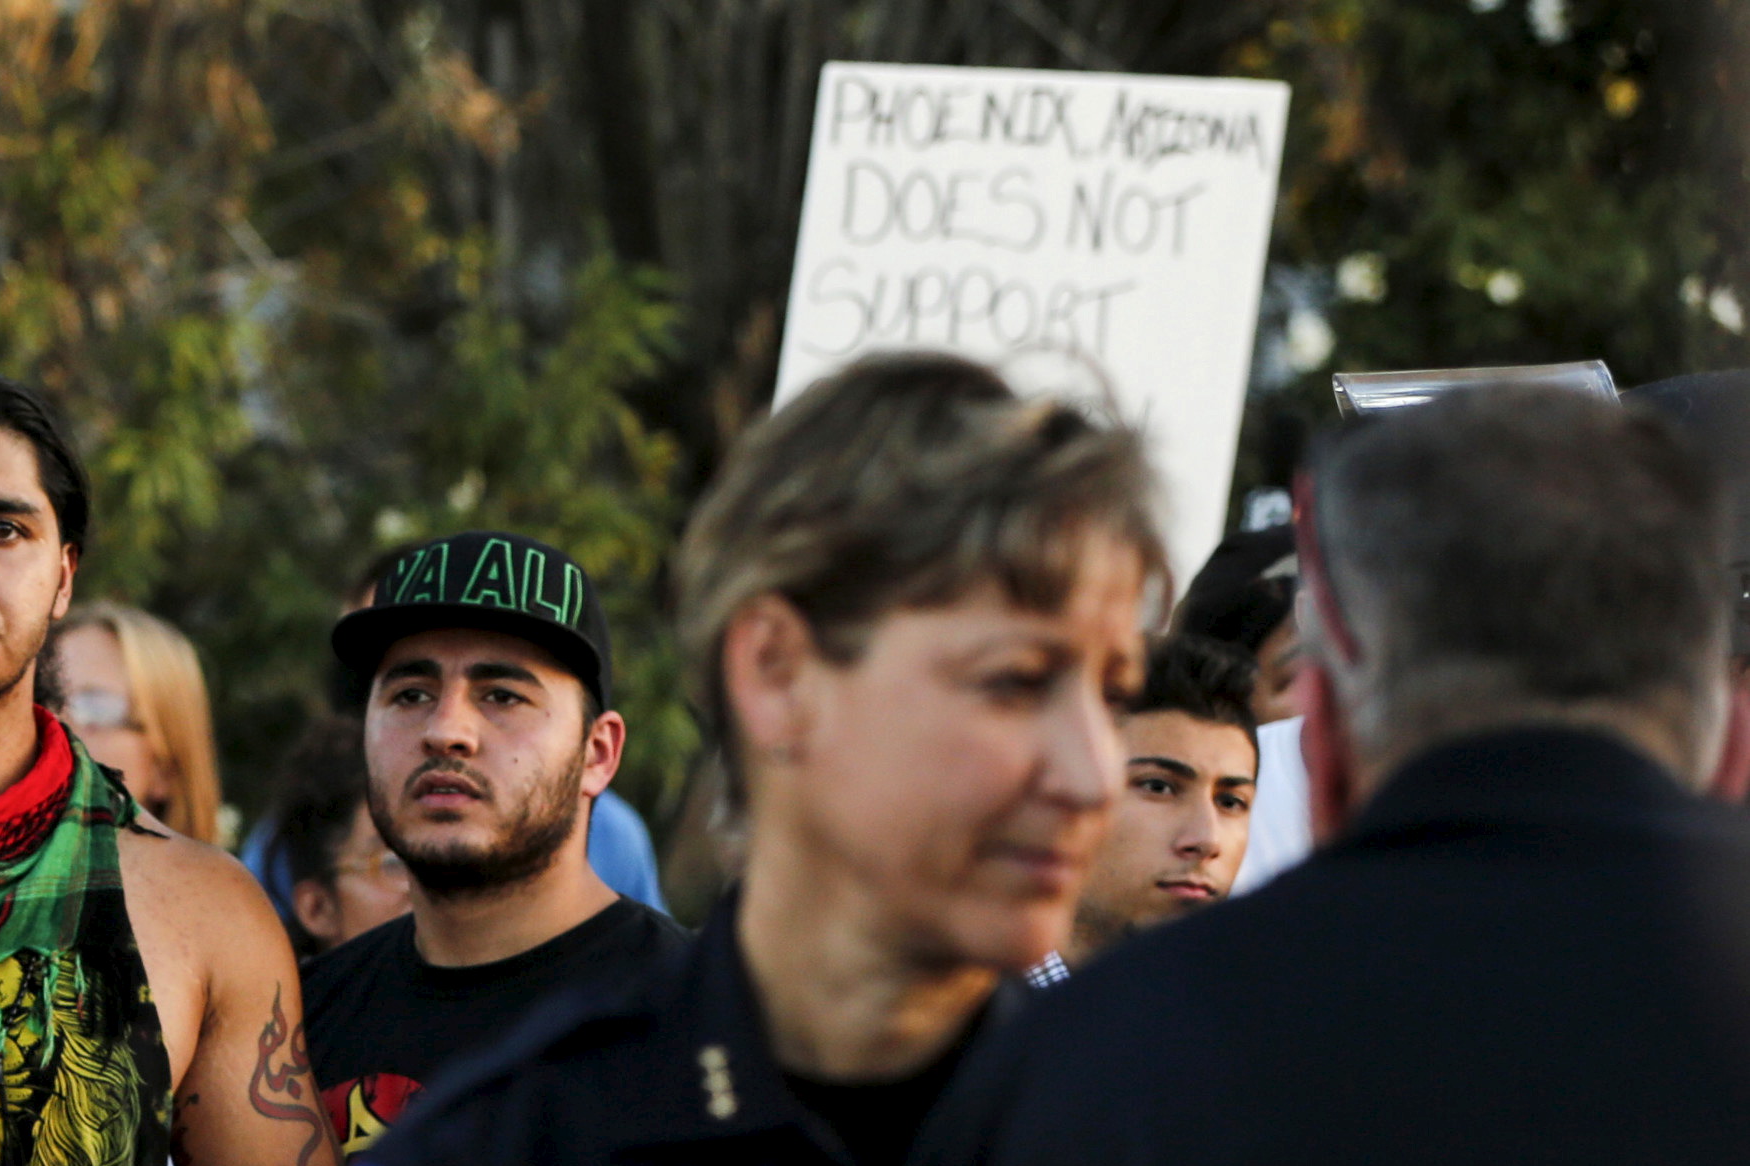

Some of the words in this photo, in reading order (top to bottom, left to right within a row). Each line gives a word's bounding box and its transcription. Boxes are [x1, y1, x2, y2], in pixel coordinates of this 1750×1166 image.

[840, 160, 1049, 254] DOES
[1062, 172, 1208, 258] NOT
[796, 256, 1138, 358] SUPPORT
